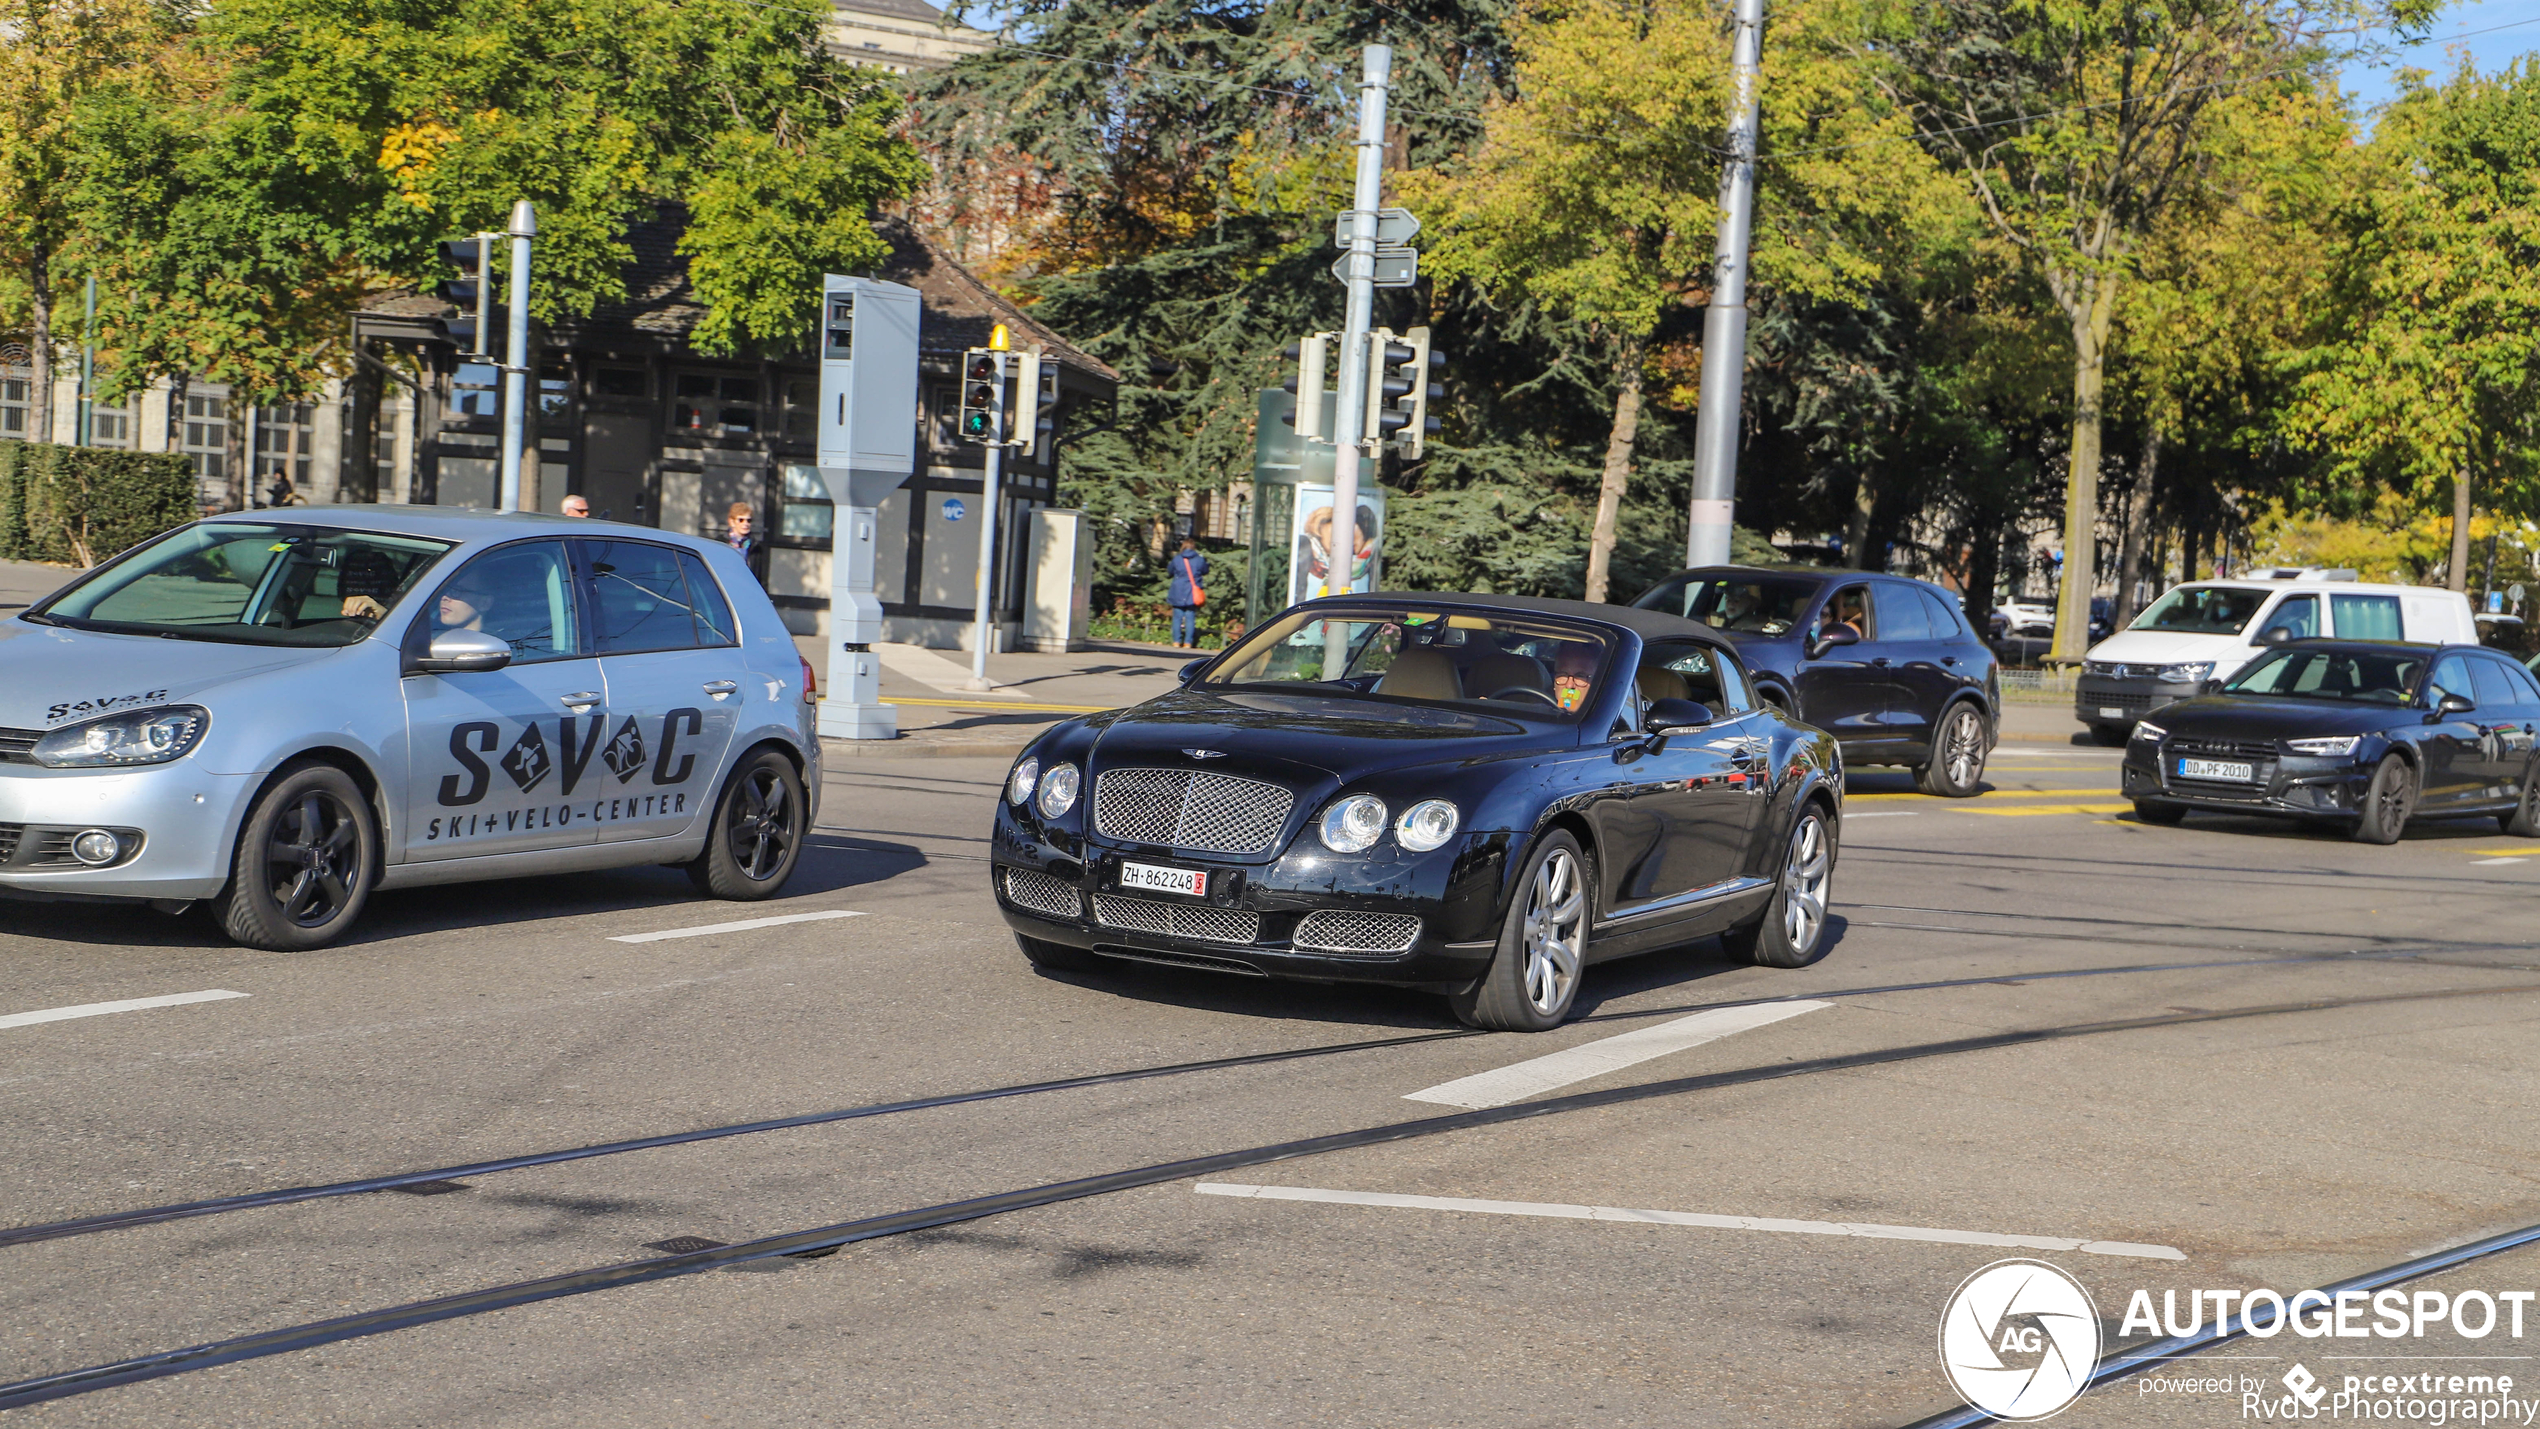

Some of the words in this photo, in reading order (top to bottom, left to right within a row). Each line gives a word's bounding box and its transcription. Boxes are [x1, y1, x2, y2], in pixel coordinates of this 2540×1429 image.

[942, 506, 964, 519] WC
[2186, 761, 2200, 775] DD
[2206, 763, 2220, 776] PF
[2222, 764, 2250, 779] 2010
